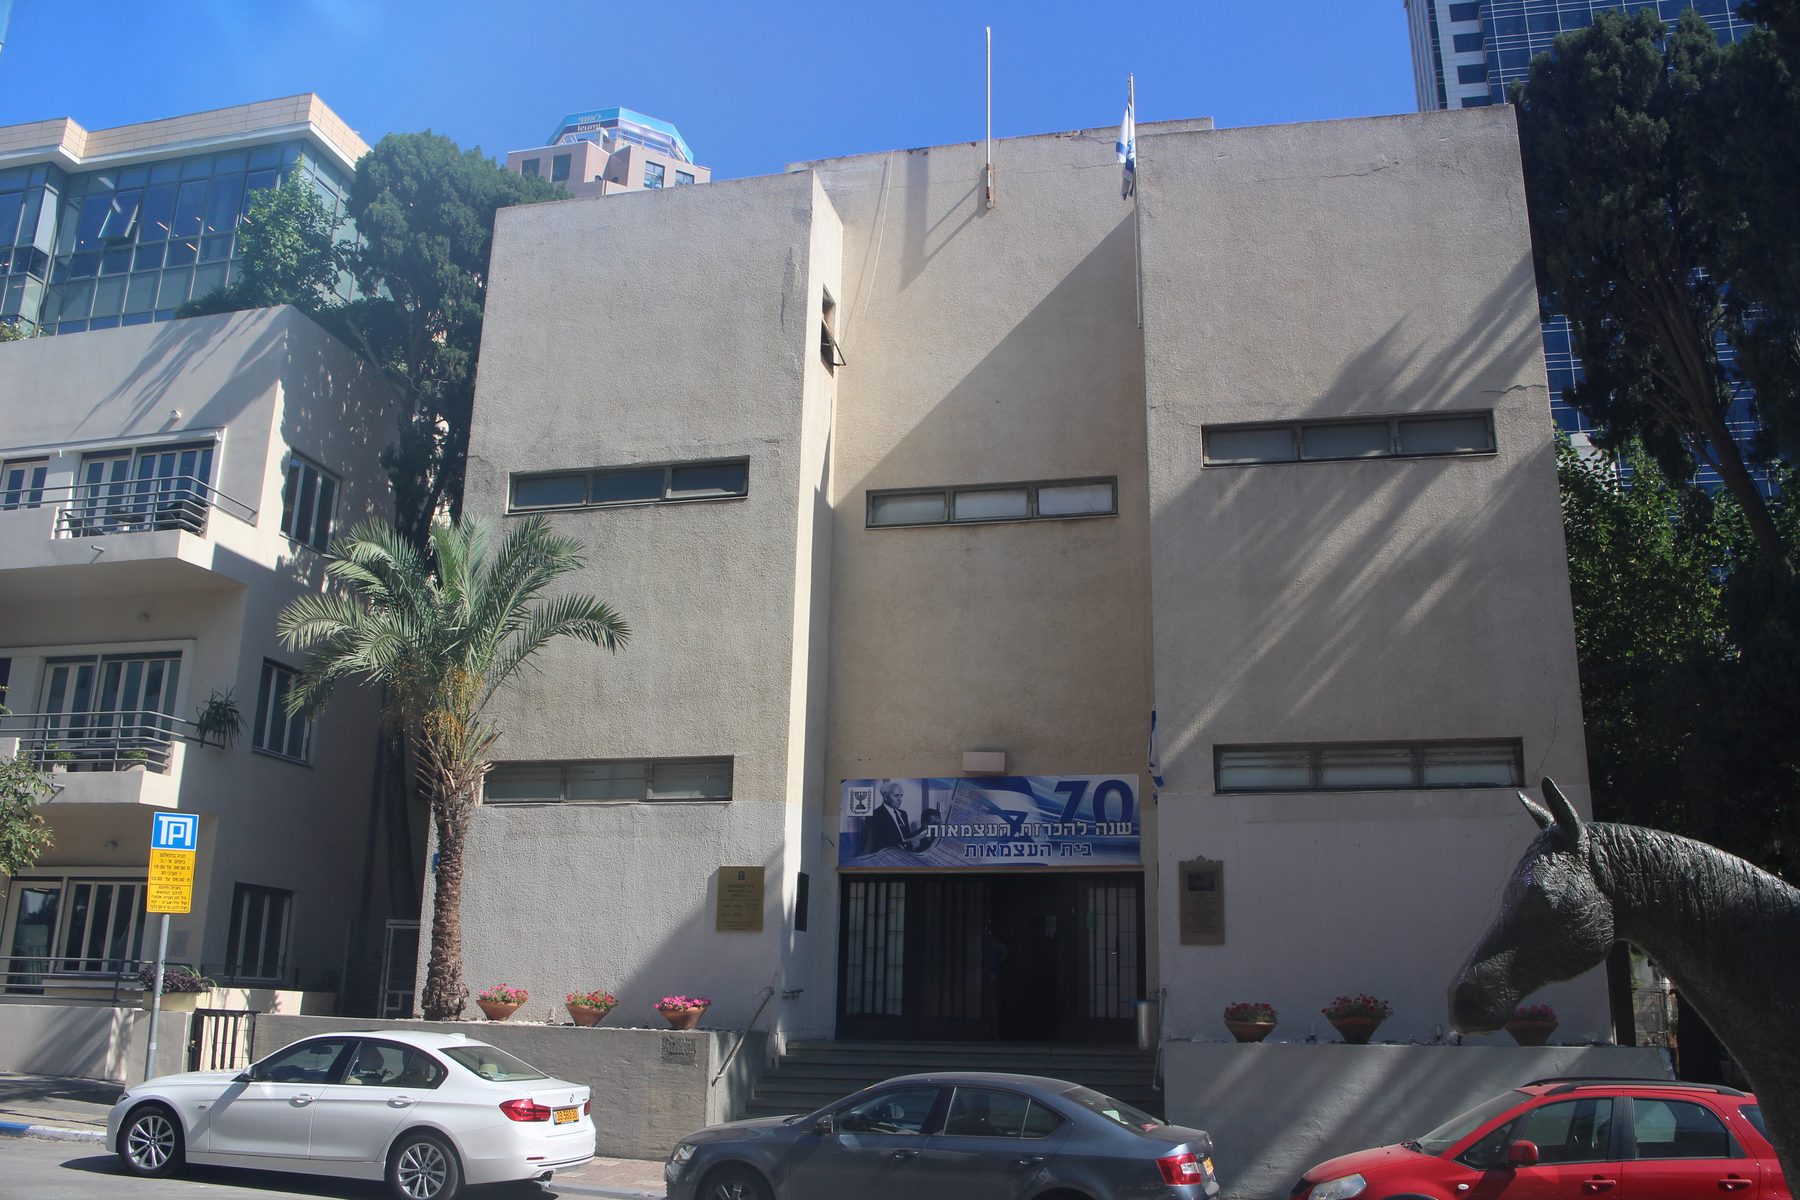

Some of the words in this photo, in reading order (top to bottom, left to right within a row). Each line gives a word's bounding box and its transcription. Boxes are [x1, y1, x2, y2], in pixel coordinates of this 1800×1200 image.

[1054, 779, 1134, 824] 70
[926, 823, 1011, 838] העצמאות
[1019, 821, 1088, 837] להכרזת
[1095, 821, 1133, 836] שנה
[964, 843, 1052, 859] העצמאות
[1060, 843, 1093, 857] בית
